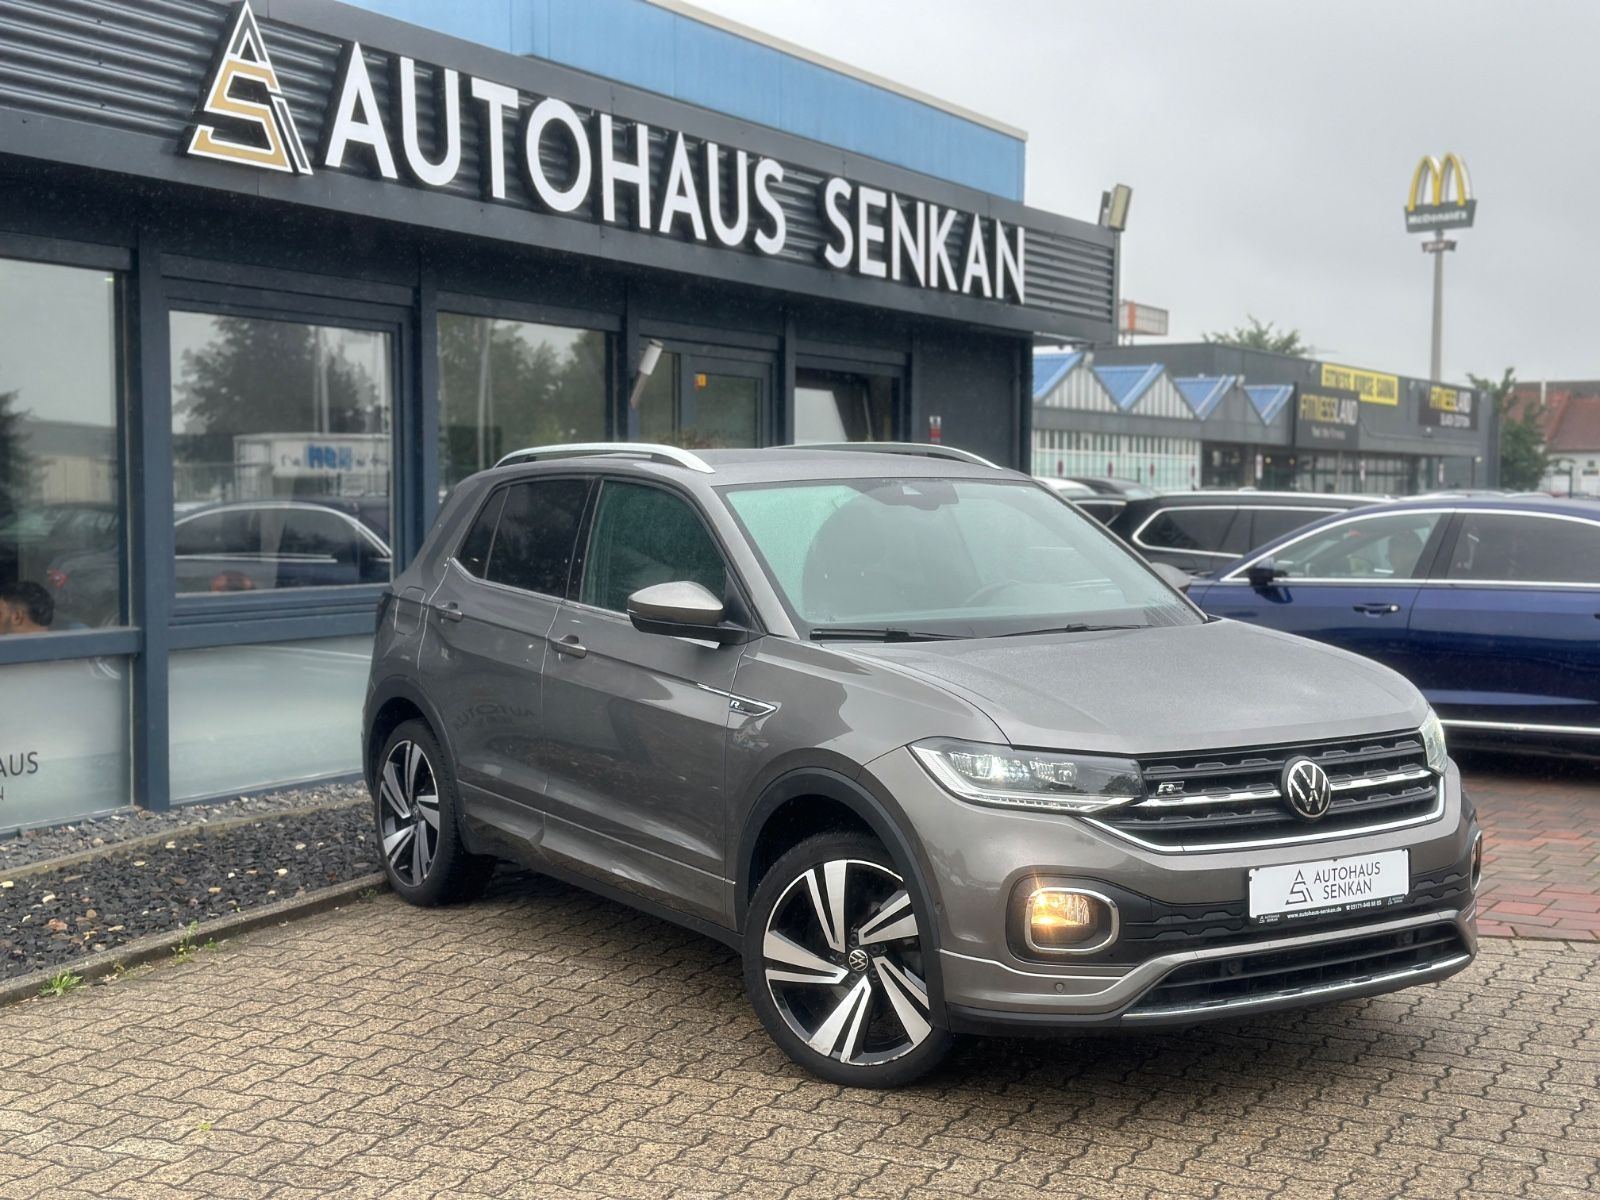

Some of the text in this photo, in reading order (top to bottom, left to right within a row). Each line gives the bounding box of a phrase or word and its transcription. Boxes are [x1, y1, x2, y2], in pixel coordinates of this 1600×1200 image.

[325, 41, 1025, 305] AUTOHAUS SENKAN
[1300, 393, 1358, 425] FITNESSLAND
[1314, 862, 1381, 884] AUTOHAUS
[1323, 879, 1372, 900] SENKAN
